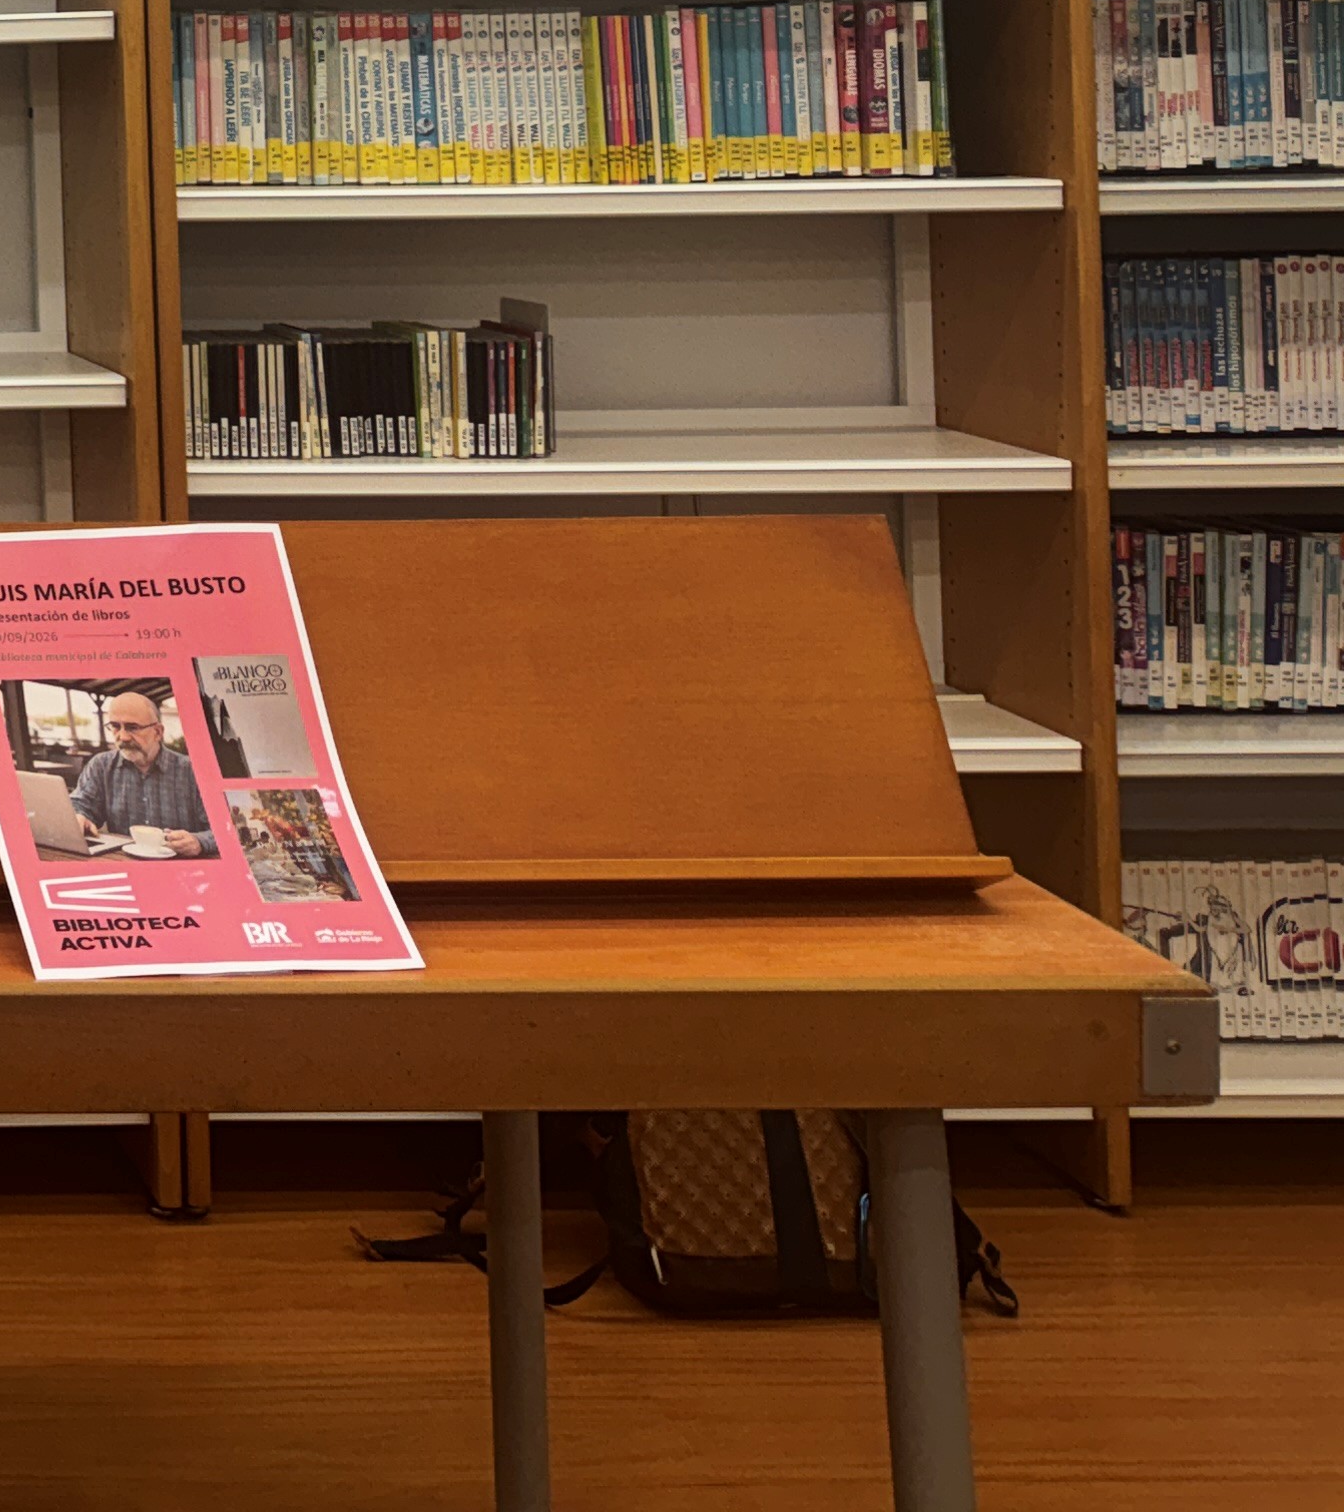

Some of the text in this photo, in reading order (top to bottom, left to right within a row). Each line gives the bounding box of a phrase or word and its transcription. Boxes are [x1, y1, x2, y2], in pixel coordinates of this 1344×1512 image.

[1214, 306, 1225, 357] lechuzas
[1228, 295, 1240, 371] hipopótamos
[33, 578, 114, 601] MARÍA
[119, 579, 164, 598] DEL
[168, 576, 246, 596] BUSTO
[72, 610, 89, 621] de
[92, 609, 131, 620] libros
[135, 628, 171, 640] 19:00
[173, 628, 182, 639] h
[217, 664, 283, 680] BLANCO
[230, 678, 287, 694] NEGRO
[52, 916, 201, 932] BIBLIOTECA
[60, 935, 153, 951] ACTIVA
